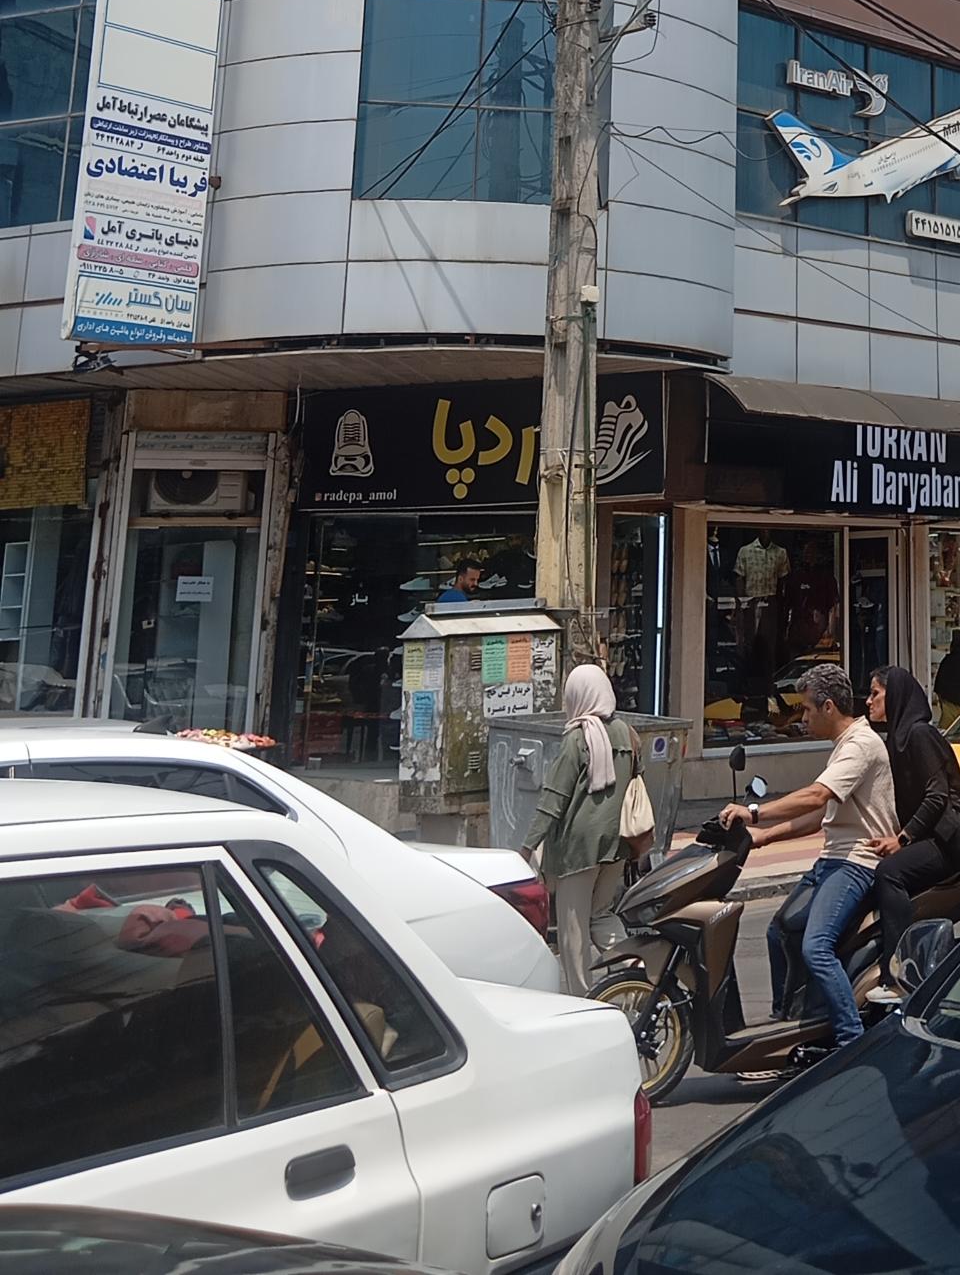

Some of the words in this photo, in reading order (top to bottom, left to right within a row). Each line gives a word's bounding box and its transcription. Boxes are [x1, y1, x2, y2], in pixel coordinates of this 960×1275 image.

[96, 96, 118, 112] آمل
[117, 99, 148, 121] ارتباط
[146, 113, 167, 123] عصر
[168, 114, 209, 137] پیشگامان
[86, 155, 165, 184] اعتضادی
[169, 166, 208, 198] فریبا
[101, 220, 125, 235] آمل
[126, 229, 163, 244] باتری
[165, 233, 199, 250] دنیای
[127, 288, 162, 308] گستر
[164, 294, 192, 313] سان
[77, 321, 95, 332] اداری
[95, 324, 109, 333] های
[129, 328, 144, 341] انواع
[432, 398, 537, 500] ادپا
[830, 460, 858, 503] Ali
[350, 593, 369, 607] باز
[486, 689, 498, 699] حج
[498, 688, 511, 698] فیش
[512, 686, 531, 698] خریدار
